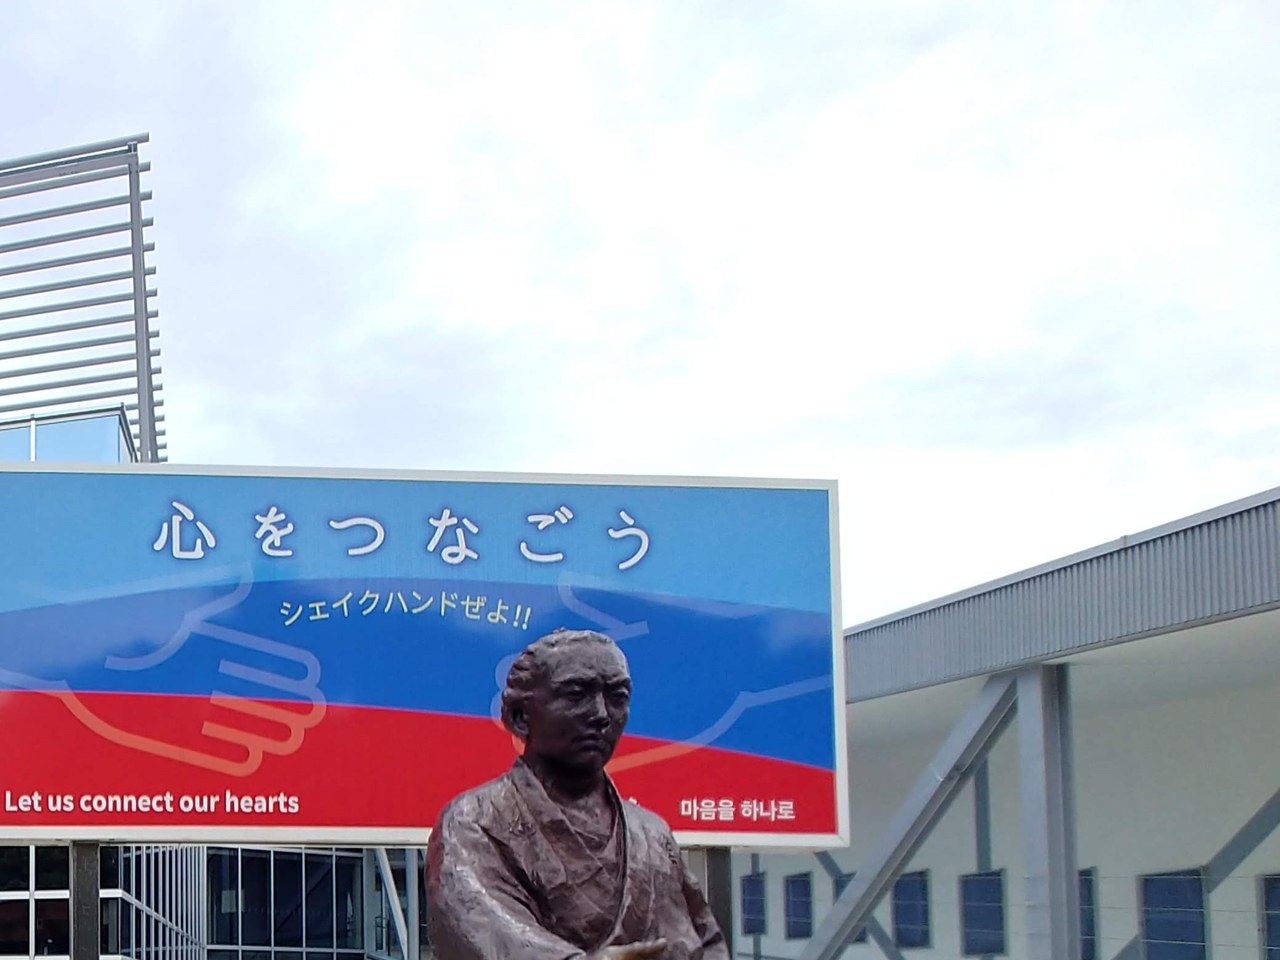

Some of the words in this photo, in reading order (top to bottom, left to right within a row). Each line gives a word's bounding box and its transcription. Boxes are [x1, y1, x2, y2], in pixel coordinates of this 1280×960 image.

[153, 500, 652, 570] 心をつなごう
[278, 590, 533, 630] シェイクハンドぜよ!!
[5, 790, 42, 812] Let
[48, 794, 74, 812] us
[80, 792, 174, 813] connect
[179, 794, 219, 813] our
[225, 790, 299, 814] hearts
[680, 797, 735, 822] 마음을
[740, 799, 796, 822] 하나로
